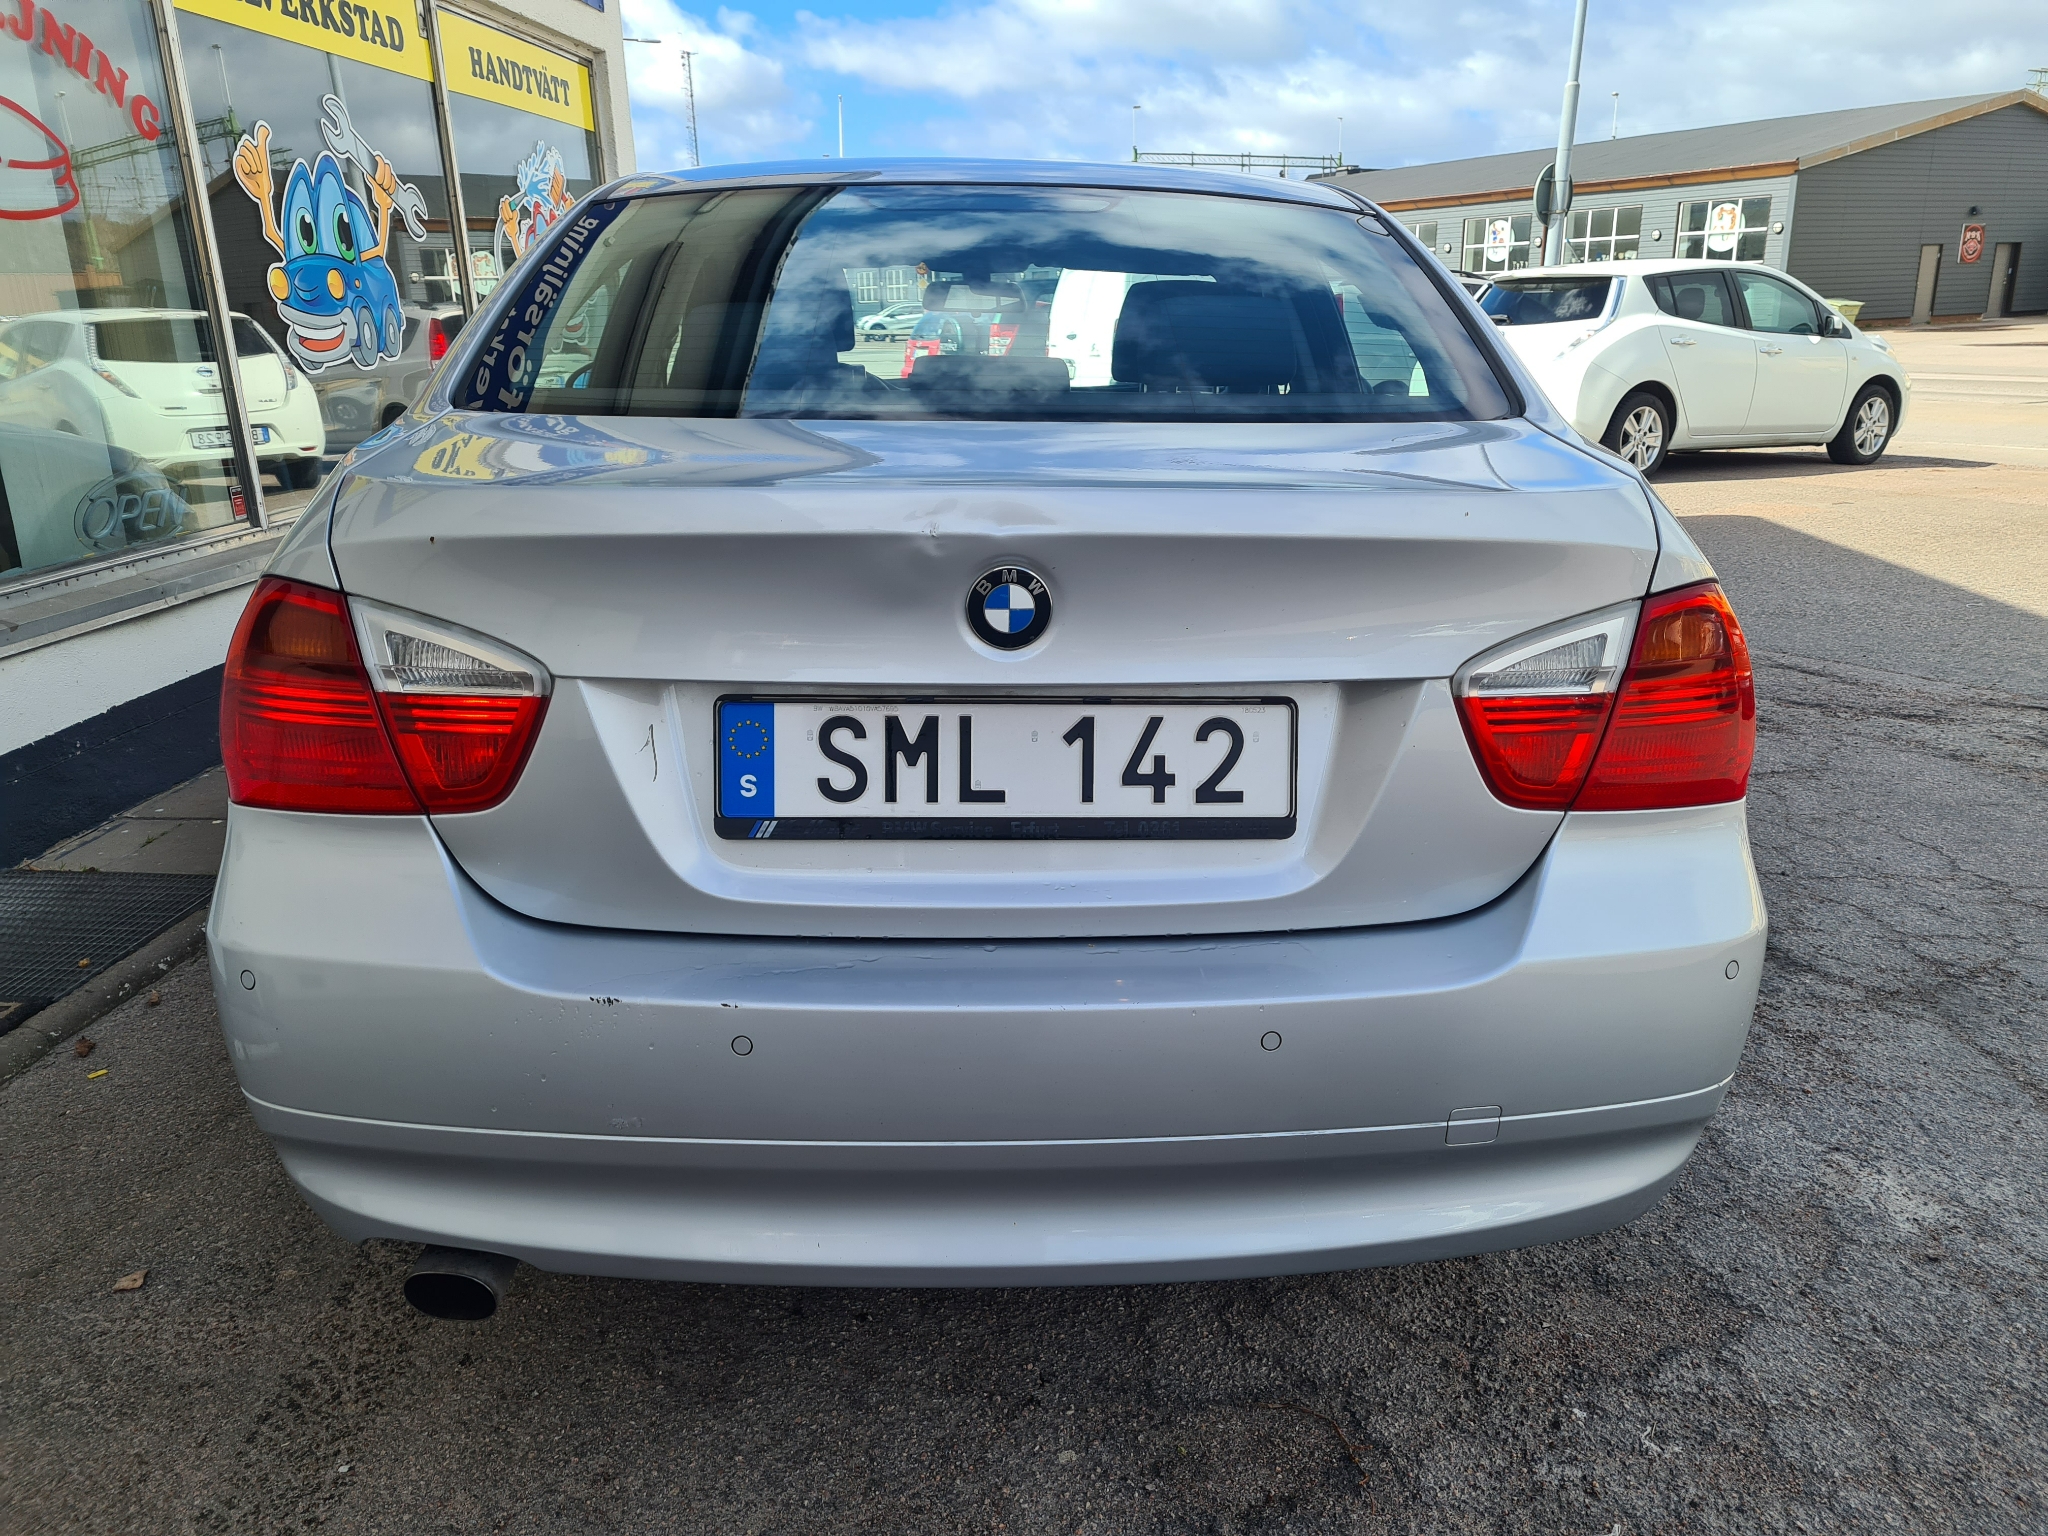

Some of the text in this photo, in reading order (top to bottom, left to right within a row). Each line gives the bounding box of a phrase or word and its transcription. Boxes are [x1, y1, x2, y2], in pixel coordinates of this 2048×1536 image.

[235, 0, 404, 53] ERKSTAD
[0, 0, 161, 141] JNING
[468, 46, 570, 107] HANDTVÄTT
[82, 486, 189, 540] OPEN
[976, 569, 1045, 596] BMW
[739, 774, 758, 798] S
[816, 714, 1245, 805] SML 142
